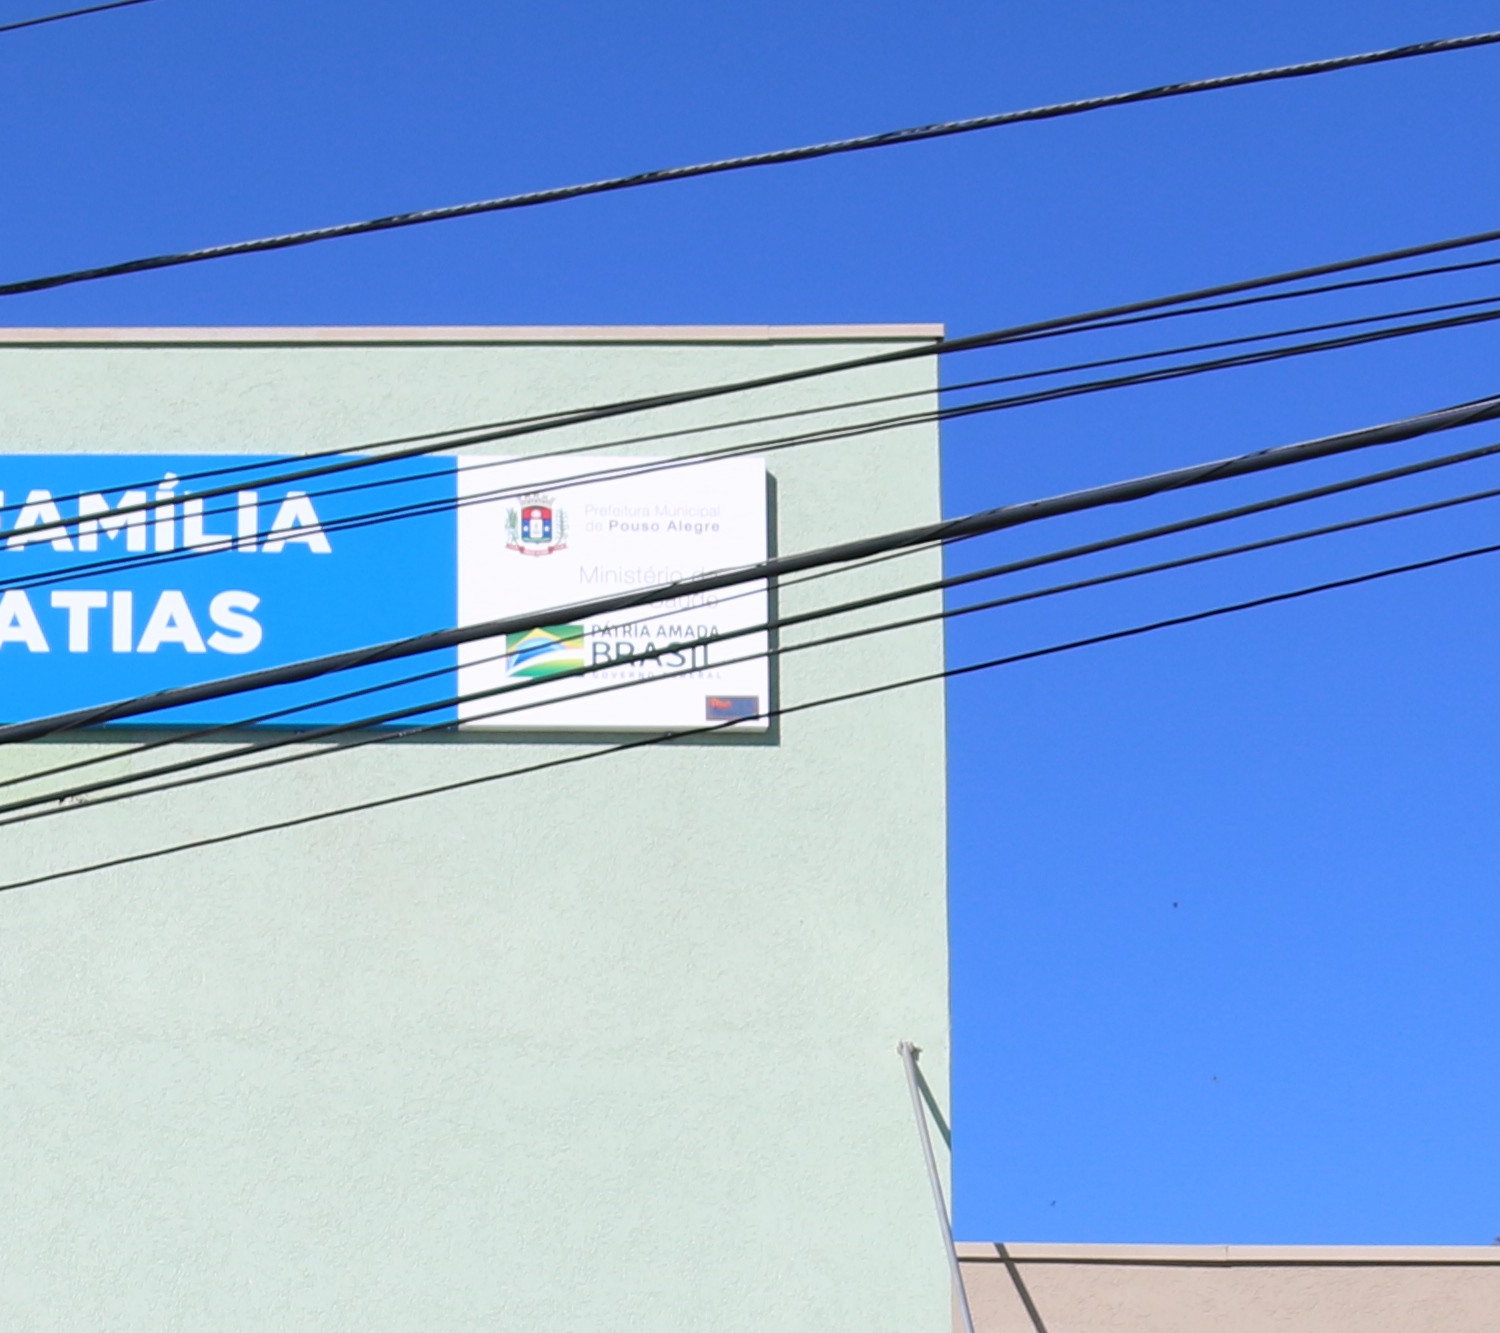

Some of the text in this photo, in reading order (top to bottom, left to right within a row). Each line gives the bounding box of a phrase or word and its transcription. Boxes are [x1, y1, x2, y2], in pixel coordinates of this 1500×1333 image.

[584, 503, 720, 519] Prefeitura Municipal
[585, 519, 720, 535] de Pouso Alegre
[579, 564, 683, 584] Ministério
[592, 621, 719, 639] PÁTRIA AMADA
